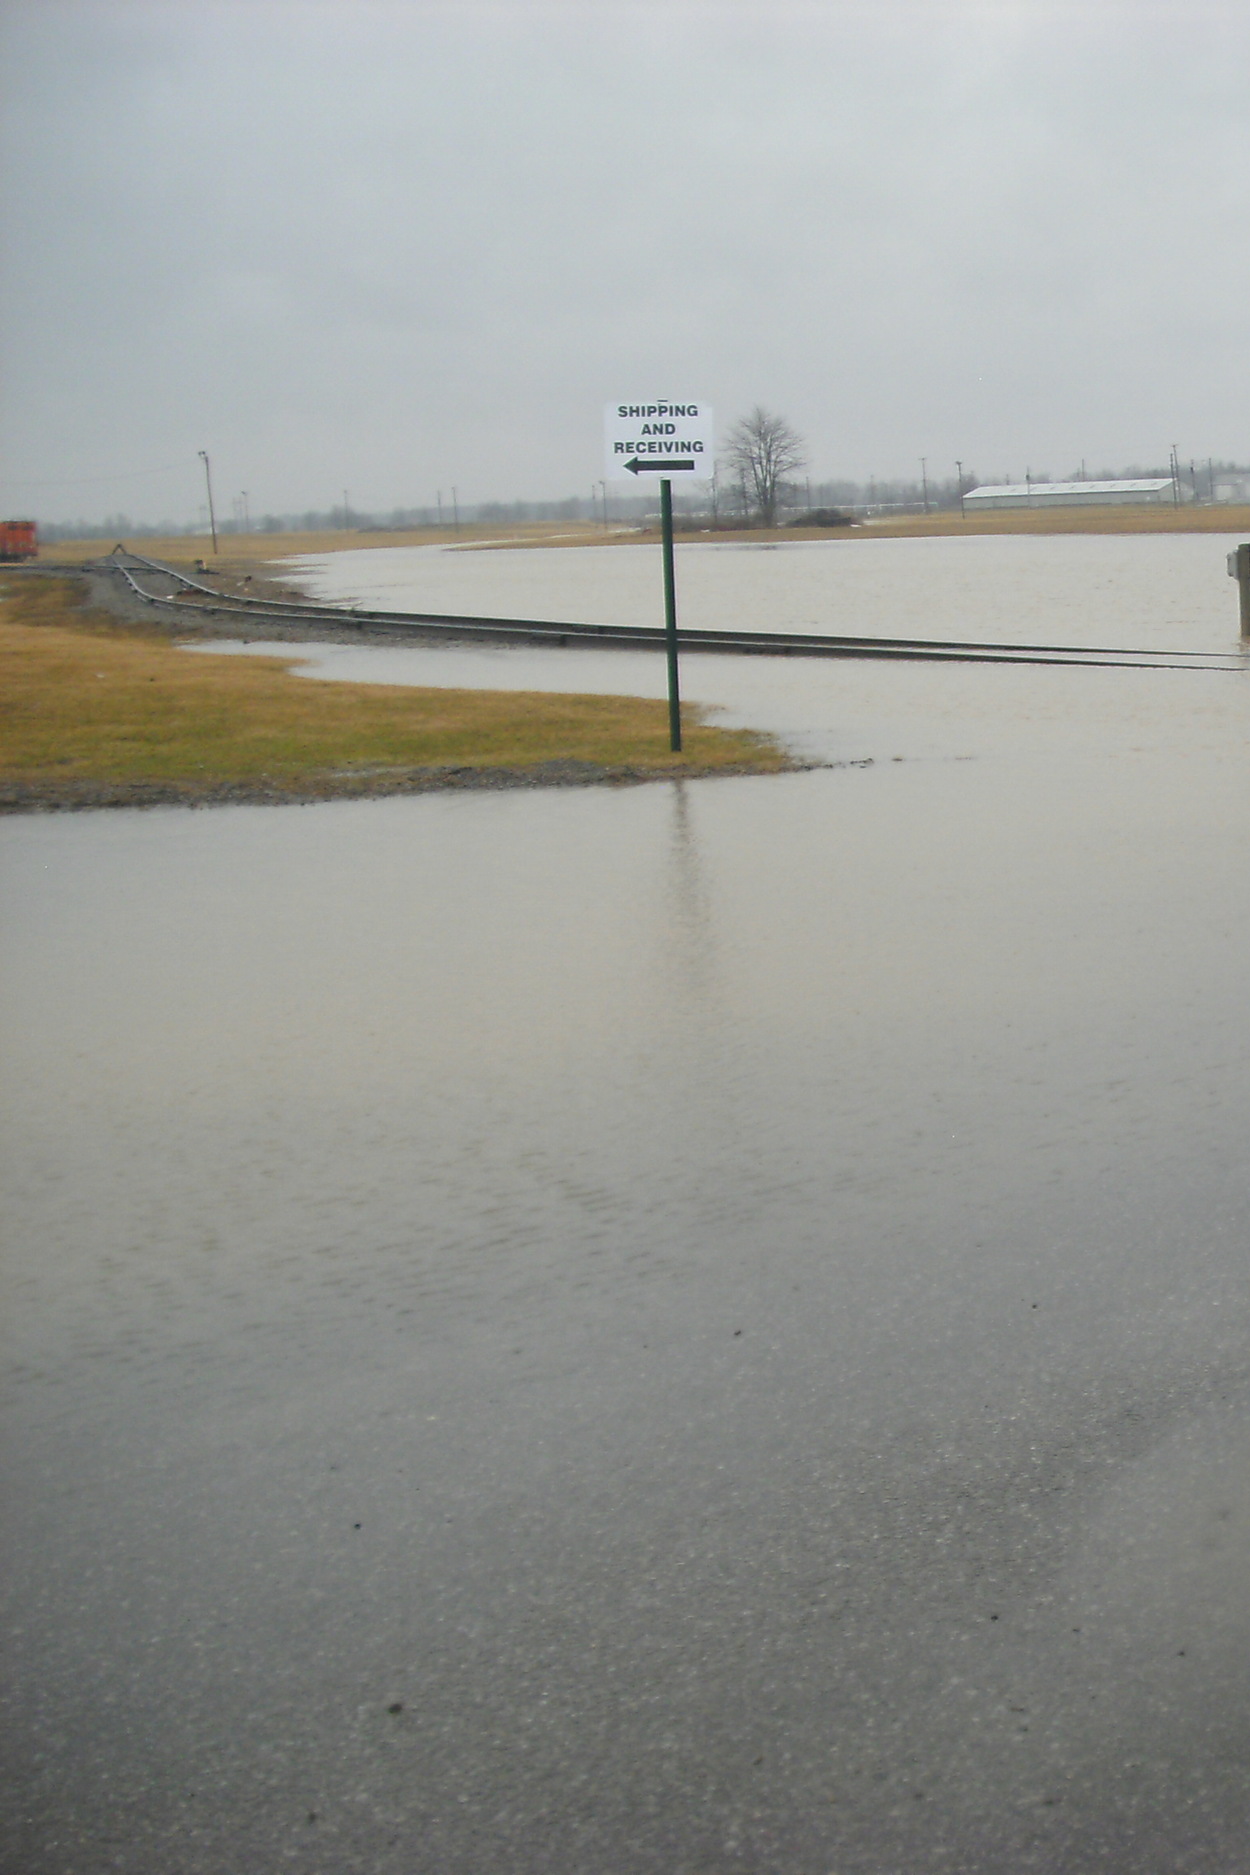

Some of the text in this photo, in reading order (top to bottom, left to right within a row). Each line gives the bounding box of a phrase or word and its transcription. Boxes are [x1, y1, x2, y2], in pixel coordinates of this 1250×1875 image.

[617, 404, 699, 418] SHIPPING
[641, 423, 676, 436] AND
[613, 440, 704, 454] RECEIVING
